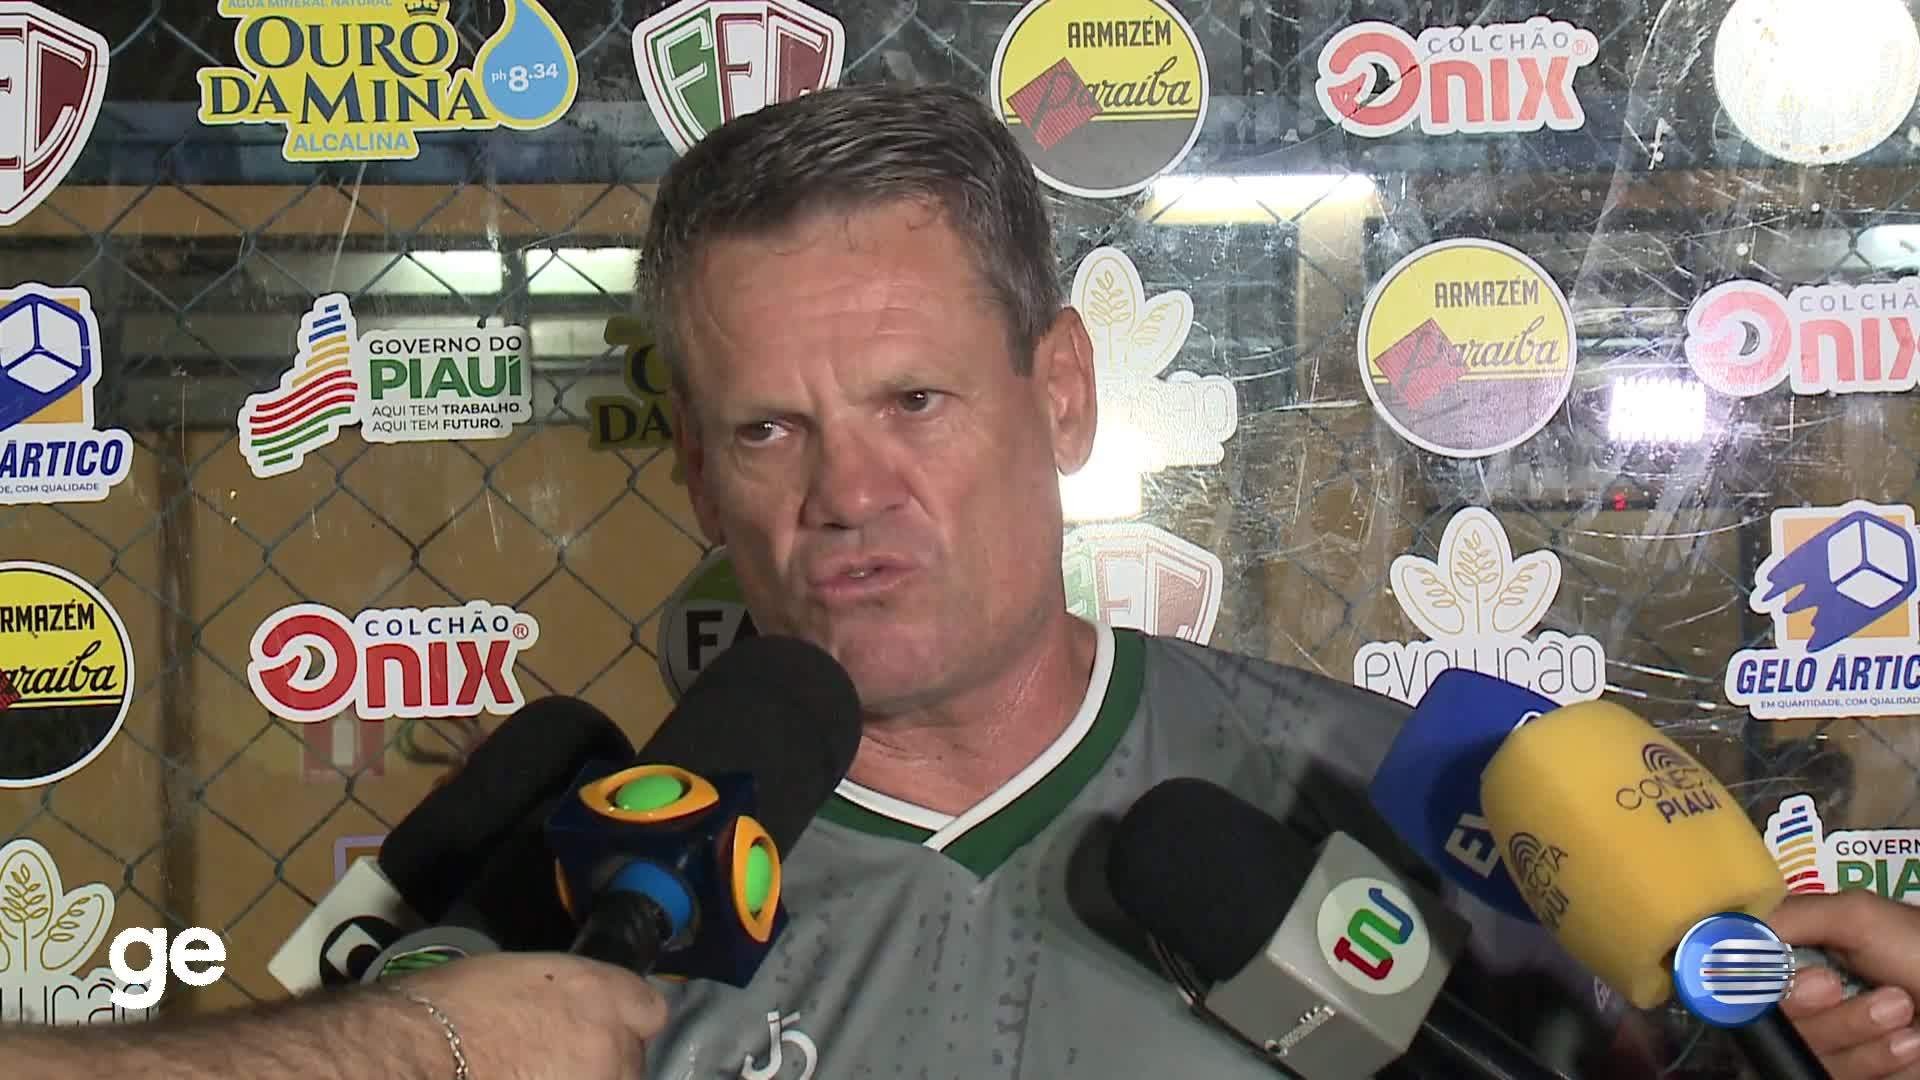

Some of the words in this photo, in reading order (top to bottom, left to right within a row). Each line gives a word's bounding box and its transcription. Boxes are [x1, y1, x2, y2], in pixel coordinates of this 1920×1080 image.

[1068, 16, 1172, 48] ARMAZÉM
[1427, 27, 1570, 55] COLCHÃO
[245, 15, 449, 78] OURO
[508, 63, 559, 92] 8.34
[209, 75, 292, 115] DA
[298, 72, 489, 124] MINA
[1031, 55, 1193, 130] Paraíba
[293, 131, 409, 152] ALCALINA
[1435, 275, 1539, 307] ARMAZÉM
[369, 337, 481, 355] GOVERNO
[489, 336, 523, 351] DO
[369, 355, 523, 400] PIAUÍ
[372, 405, 406, 418] AQUI
[409, 404, 438, 416] TEM
[442, 402, 522, 415] TRABALHO.
[372, 420, 406, 433] AQUI
[410, 419, 439, 431] TEM
[443, 418, 503, 430] FUTURO.
[16, 484, 38, 493] COM
[41, 482, 98, 493] QUALIDADE
[365, 611, 509, 637] COLCHÃO
[1736, 657, 1817, 694] GELO
[1761, 700, 1775, 708] EM
[1777, 698, 1842, 709] QUANTIDADE,
[1845, 696, 1868, 706] COM
